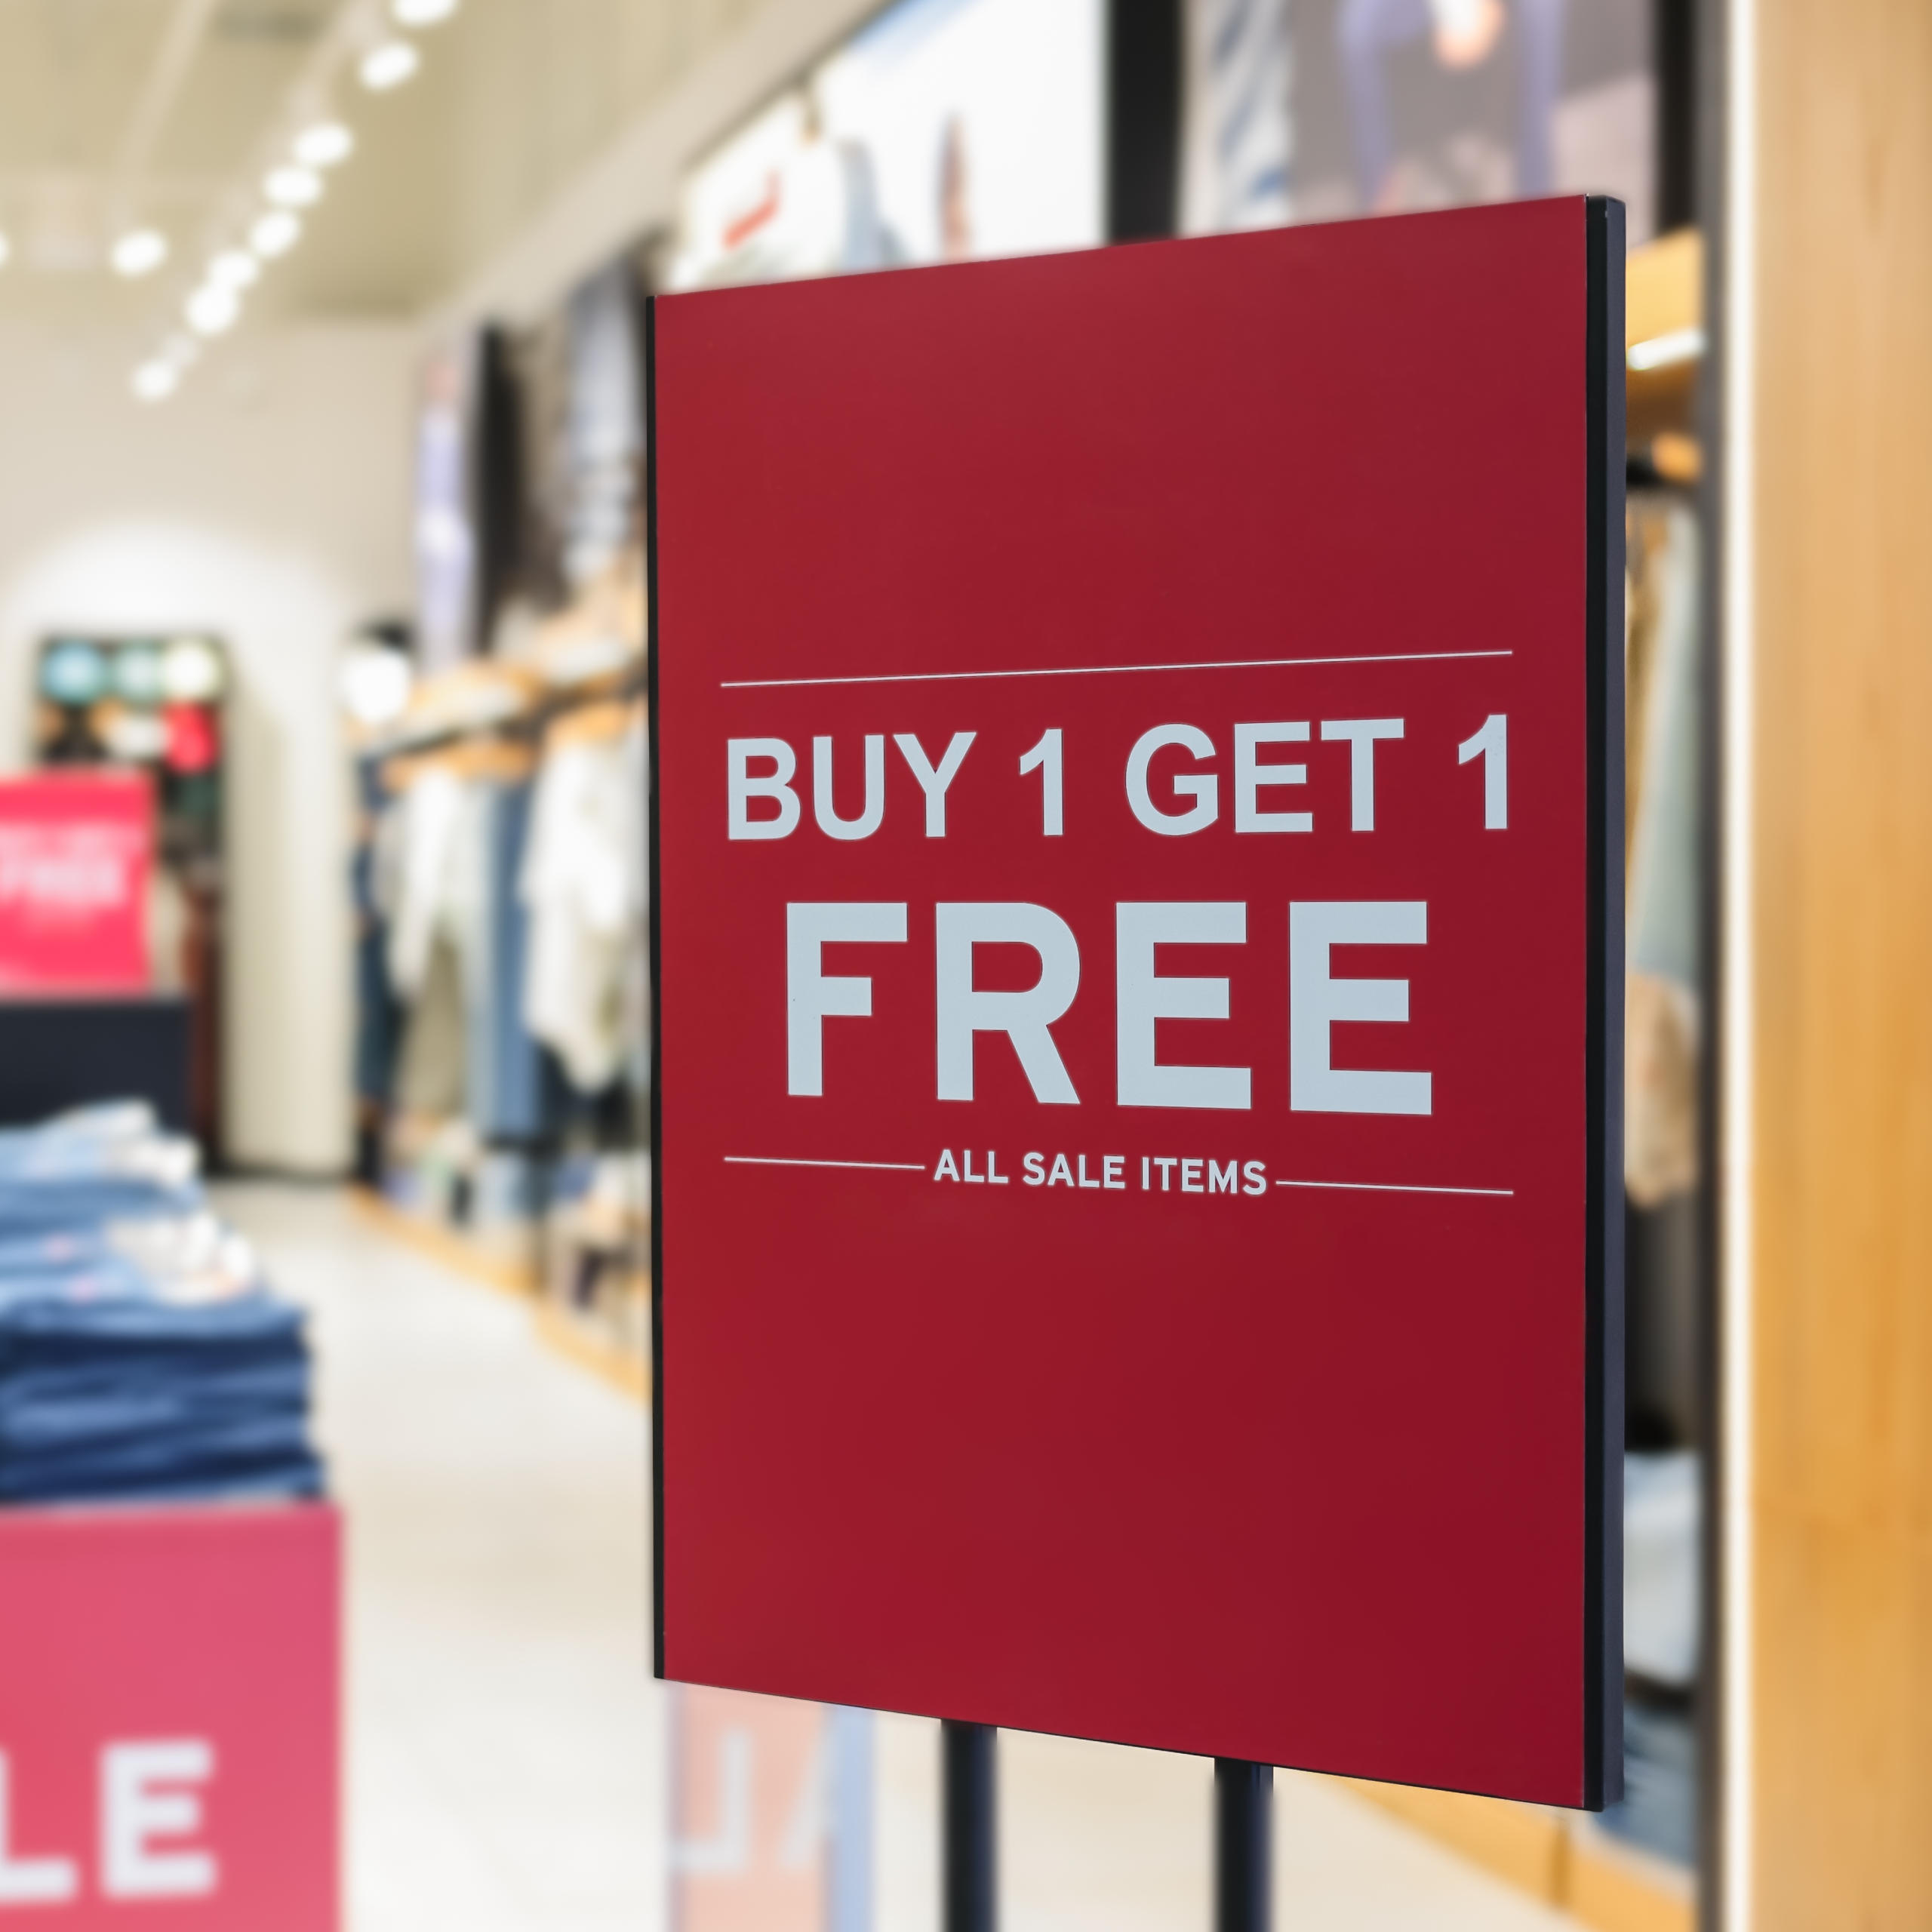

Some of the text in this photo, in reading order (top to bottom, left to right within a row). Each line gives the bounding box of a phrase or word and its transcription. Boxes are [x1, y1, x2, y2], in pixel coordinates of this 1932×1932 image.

[728, 714, 1507, 841] BUY 1 GET 1
[786, 901, 1432, 1115] FREE
[934, 1149, 1267, 1195] ALL SALE ITEMS
